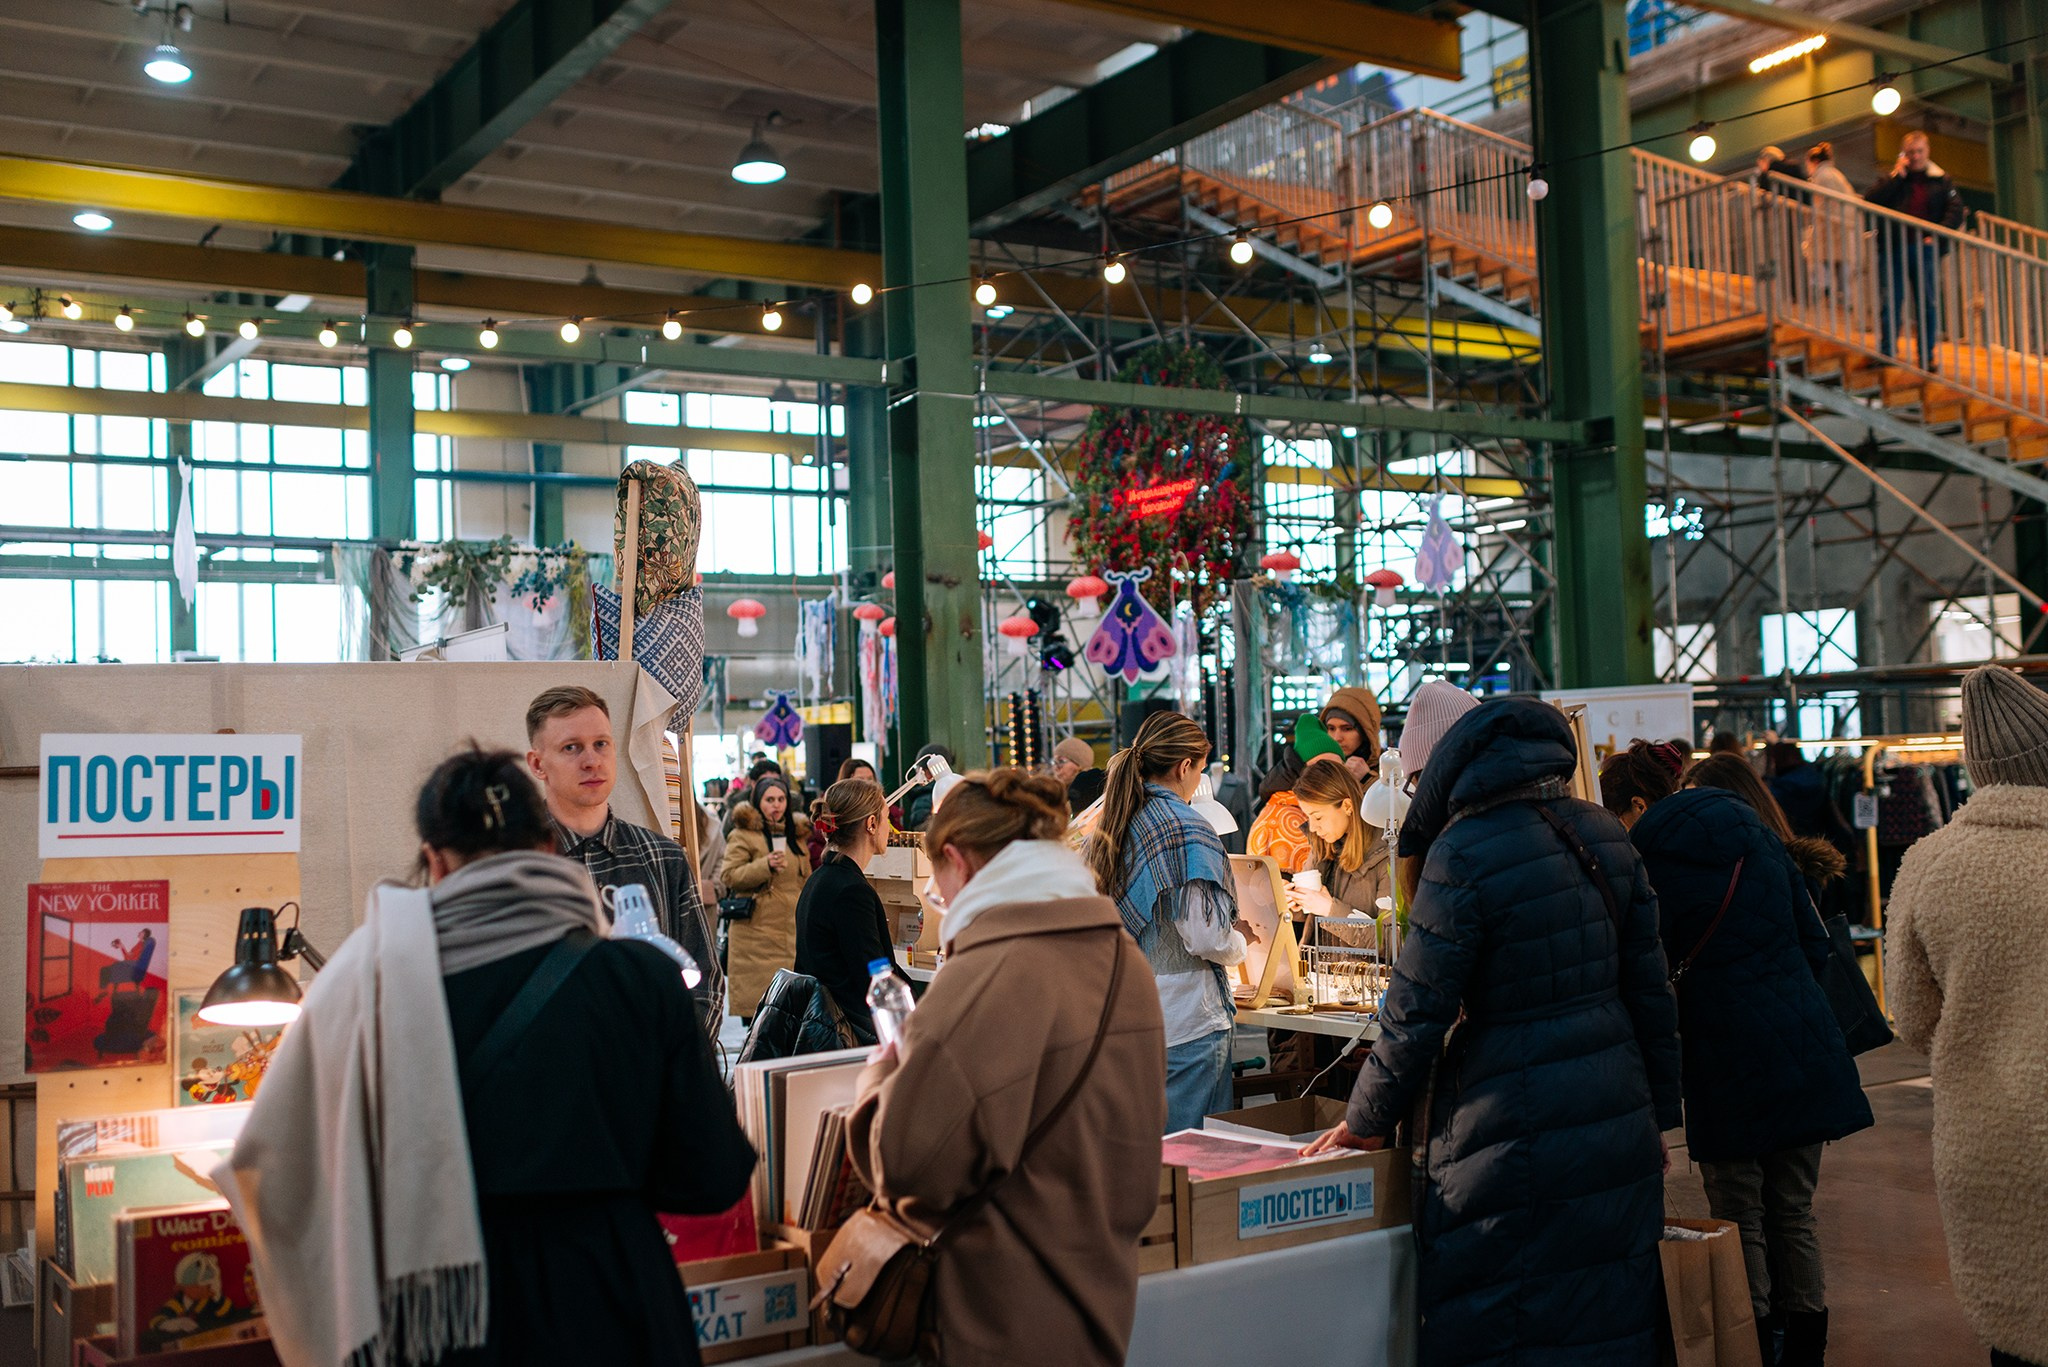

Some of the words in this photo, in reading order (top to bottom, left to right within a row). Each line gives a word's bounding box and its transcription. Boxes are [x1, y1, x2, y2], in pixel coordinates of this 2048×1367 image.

[47, 754, 295, 824] ПОСТЕРЫ
[91, 883, 112, 892] THE
[38, 893, 83, 912] NEW
[87, 892, 160, 912] YORKER
[86, 1180, 114, 1198] PLAY
[1263, 1182, 1352, 1225] ПОСТЕРЫ
